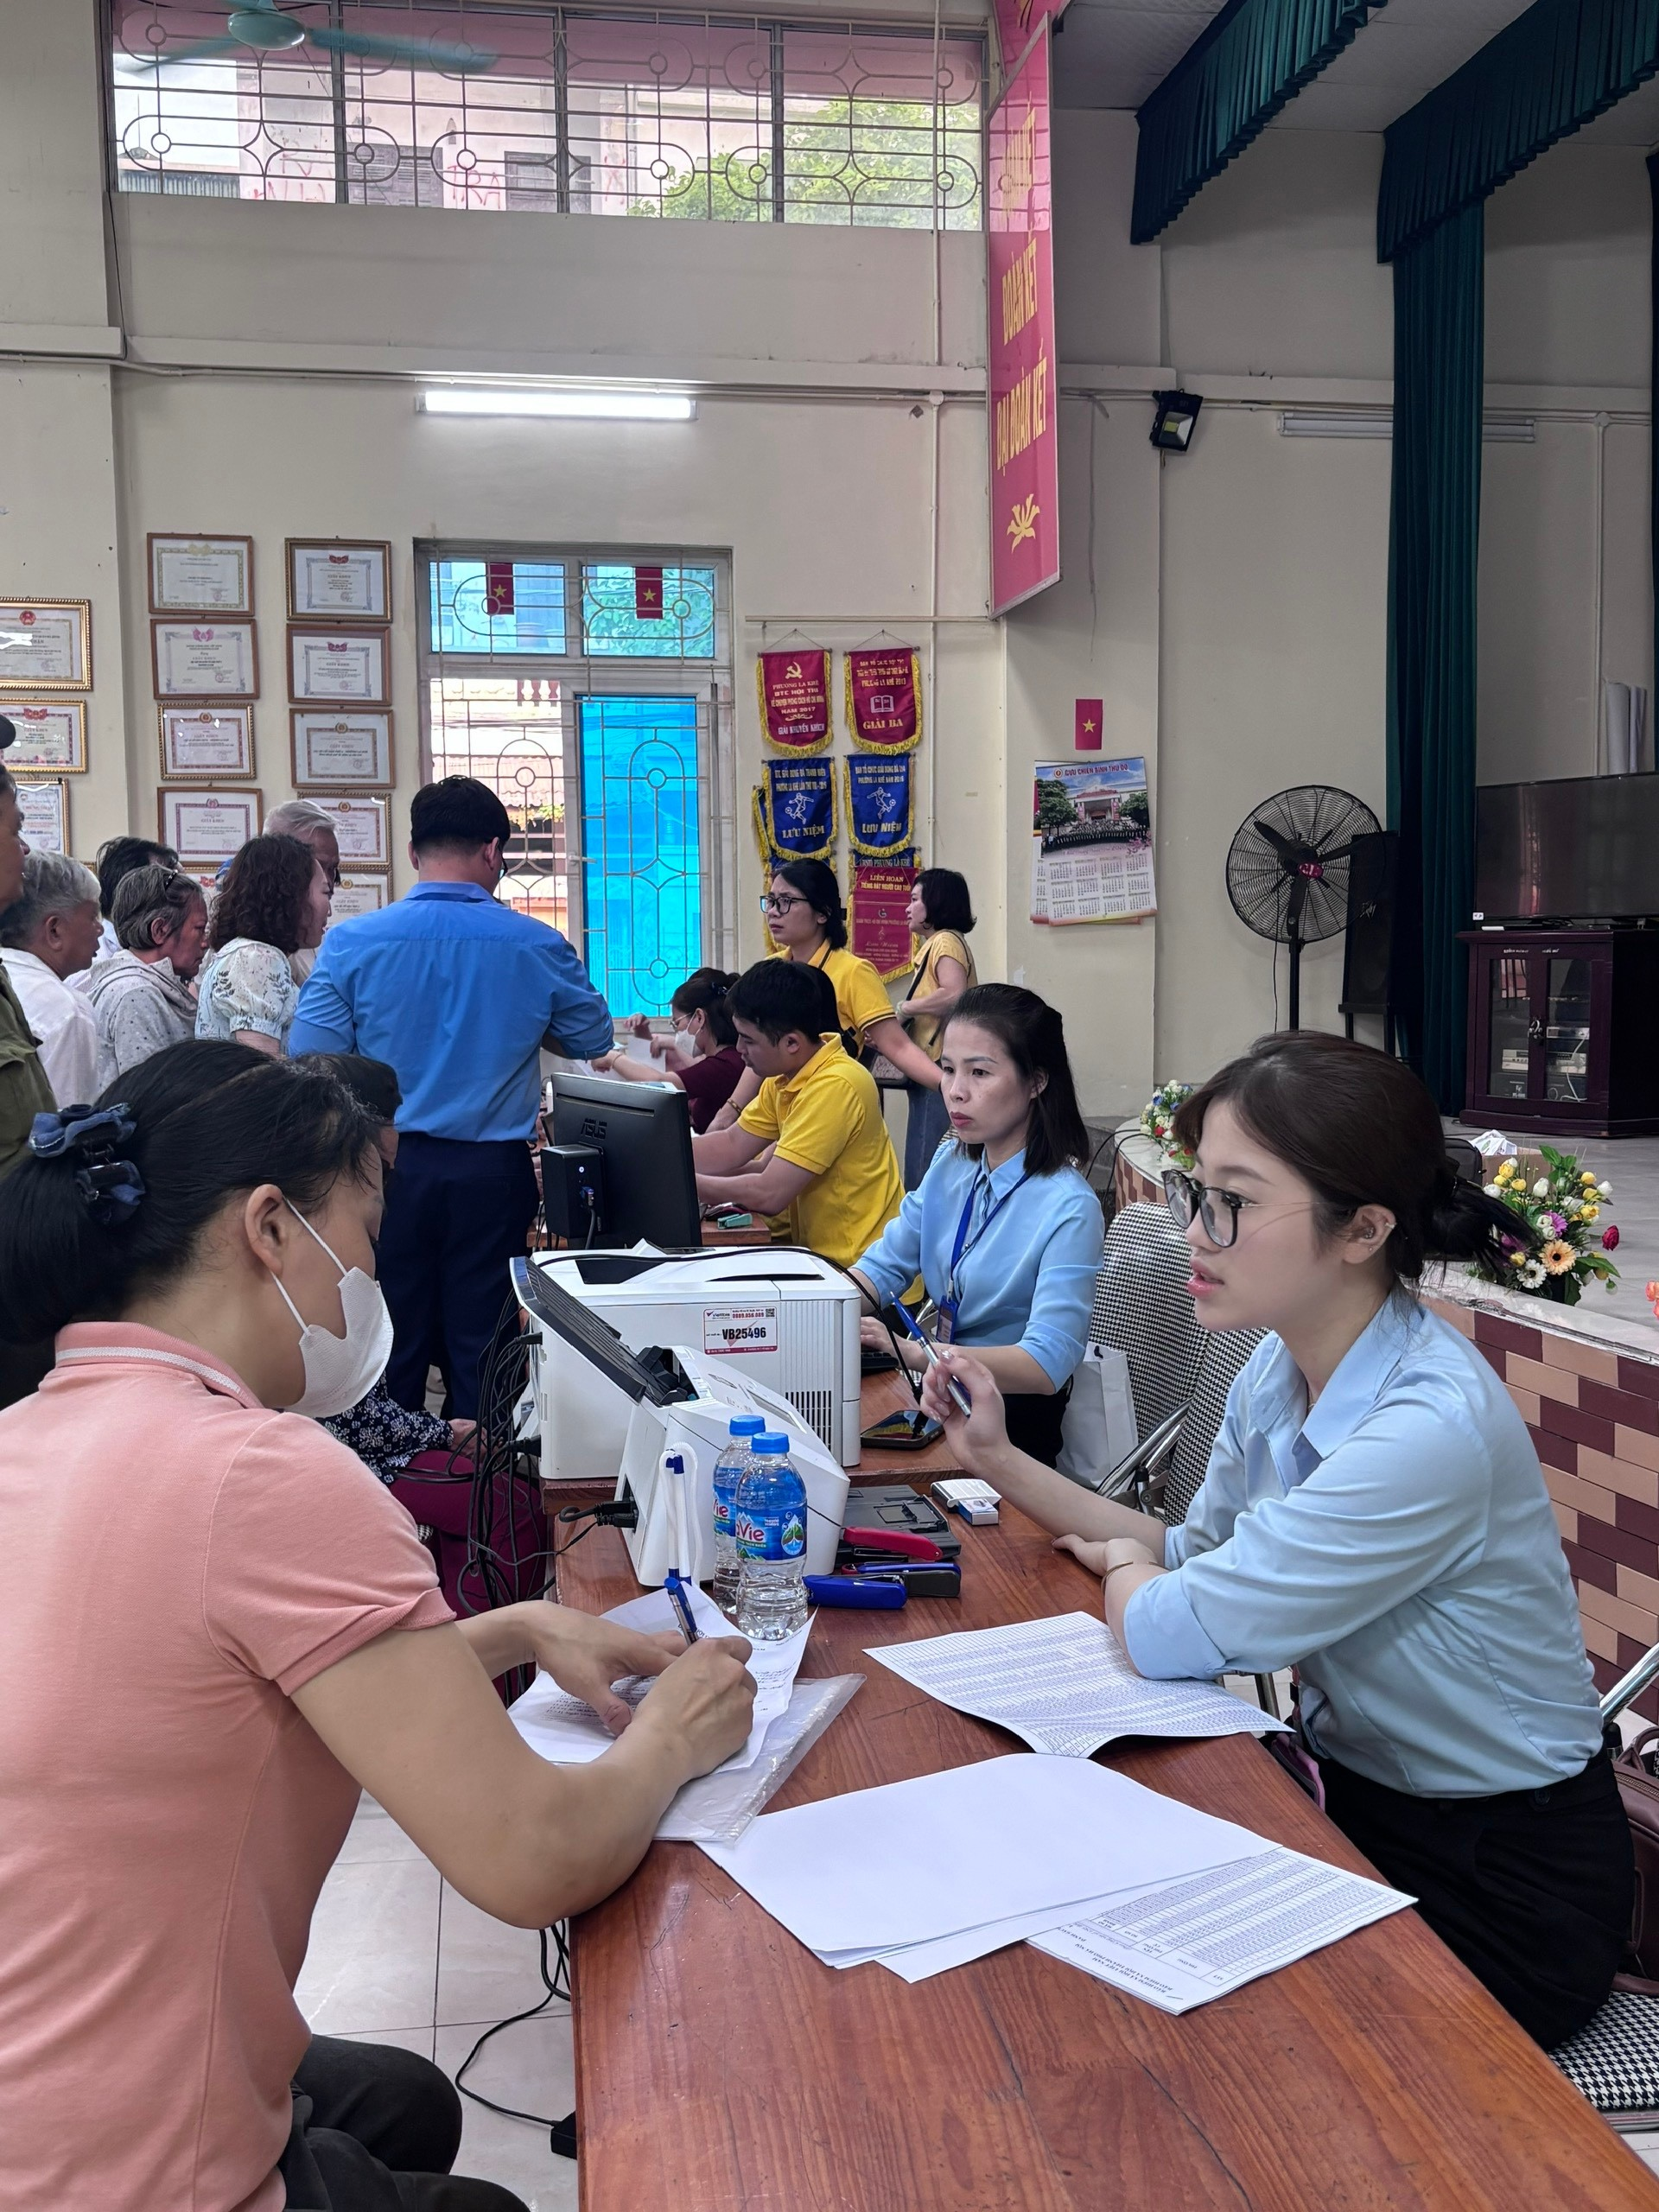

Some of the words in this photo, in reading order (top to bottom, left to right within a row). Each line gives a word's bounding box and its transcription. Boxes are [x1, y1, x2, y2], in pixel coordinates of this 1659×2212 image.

[1023, 221, 1038, 323] KẾT
[997, 393, 1009, 476] ĐẠI
[1010, 365, 1031, 459] ĐOÀN
[1033, 337, 1047, 441] KẾT
[778, 725, 789, 734] GIẢI
[862, 718, 886, 729] GIẢI
[889, 718, 904, 728] BA
[782, 828, 801, 839] LƯU
[803, 824, 825, 837] NIỆM
[862, 823, 878, 834] LƯU
[880, 821, 902, 833] NIỆM
[581, 1118, 607, 1140] ASUS
[721, 1327, 766, 1340] VB25496
